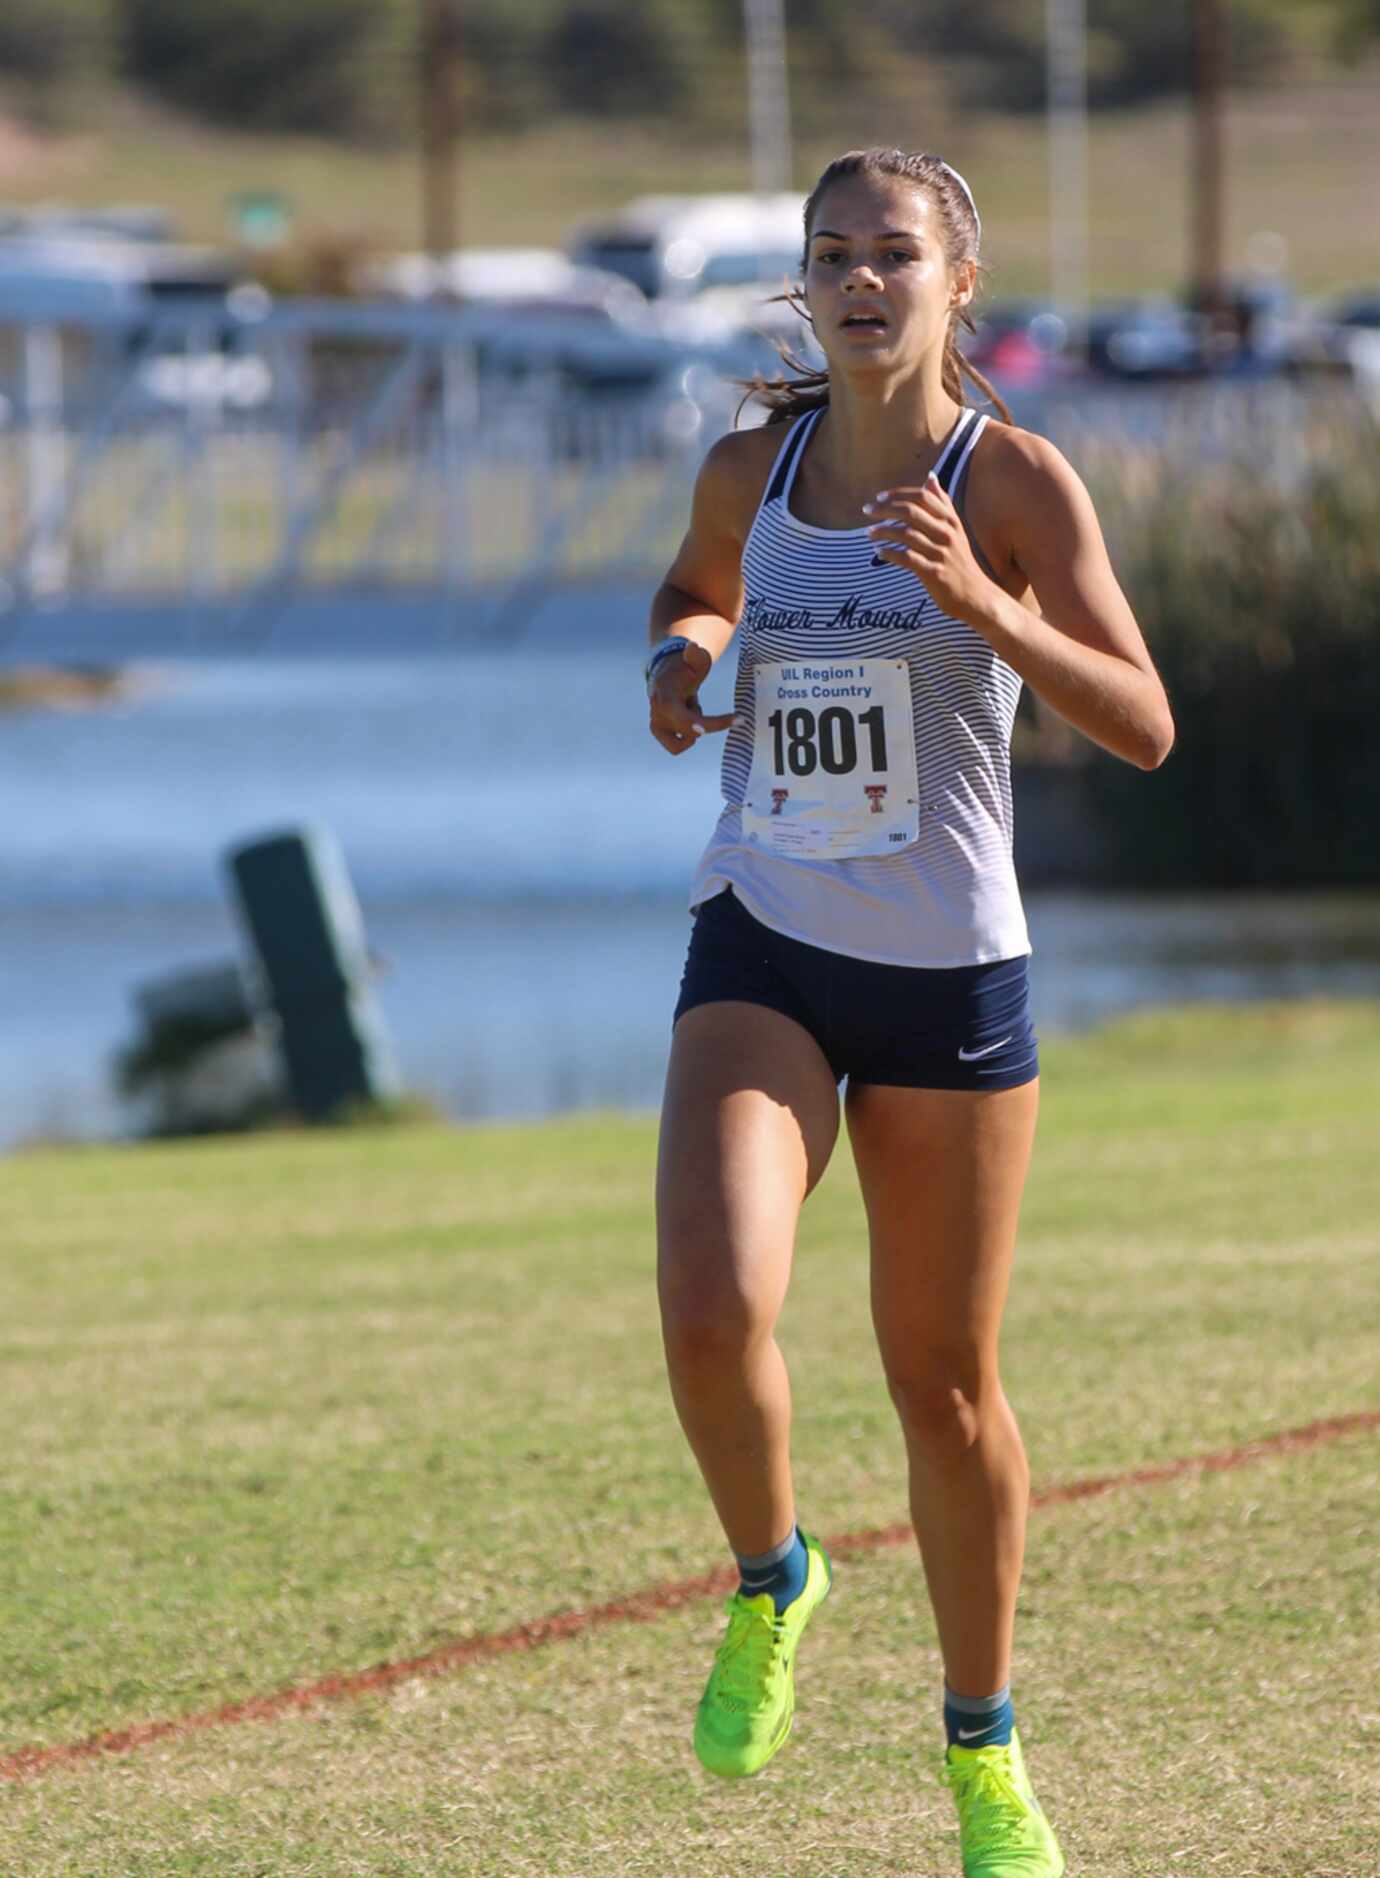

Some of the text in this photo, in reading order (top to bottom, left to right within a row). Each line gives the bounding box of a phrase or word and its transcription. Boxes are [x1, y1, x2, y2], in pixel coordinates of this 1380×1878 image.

[828, 595, 927, 632] Mound
[803, 667, 853, 682] Region
[859, 666, 865, 678] I
[811, 685, 872, 698] Country
[768, 706, 888, 777] 1801
